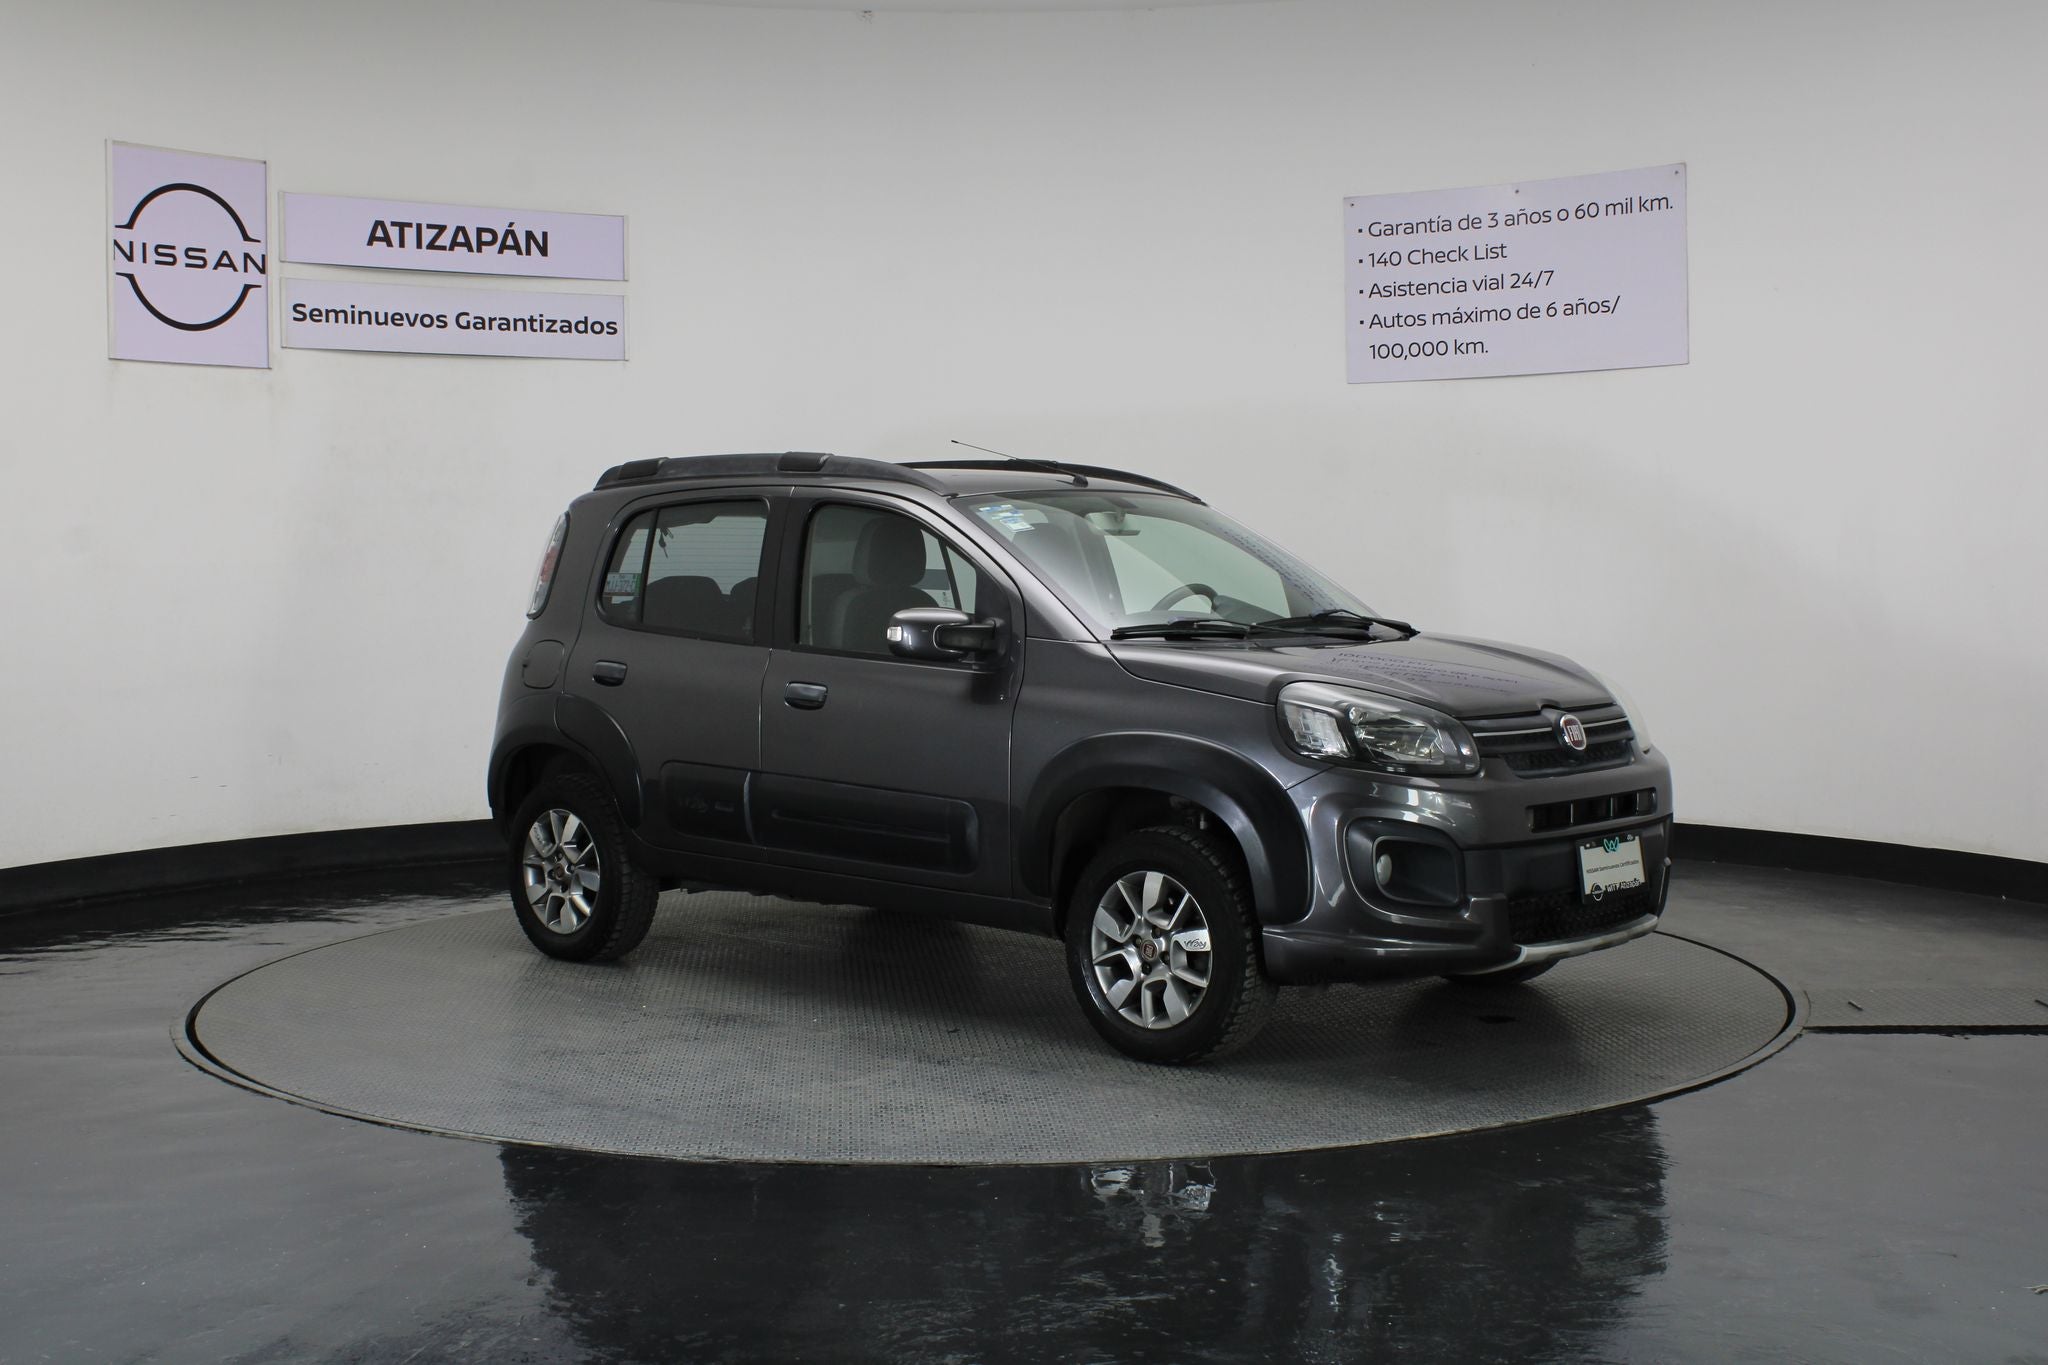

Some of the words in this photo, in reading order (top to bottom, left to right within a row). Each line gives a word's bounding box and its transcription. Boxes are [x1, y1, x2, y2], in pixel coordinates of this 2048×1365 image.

[1368, 216, 1452, 238] Garantía
[1458, 214, 1482, 230] de
[1488, 212, 1498, 228] 3
[1505, 209, 1551, 226] años
[1557, 209, 1569, 221] o
[1575, 202, 1599, 219] 60
[1606, 197, 1632, 216] mil
[1639, 196, 1673, 212] km.
[367, 220, 548, 257] ATIZAPÁN
[114, 238, 266, 275] NISSAN
[1369, 251, 1402, 267] 140
[1408, 246, 1469, 265] Check
[1475, 244, 1507, 260] List
[1369, 277, 1467, 298] Asistencia
[1473, 274, 1504, 291] vial
[1510, 270, 1554, 289] 24/7
[293, 303, 448, 329] Seminuevos
[455, 312, 618, 335] Garantizados
[1369, 313, 1426, 329] Autos
[1432, 307, 1511, 325] máximo
[1517, 303, 1540, 319] de
[1546, 302, 1557, 317] 6
[1563, 296, 1620, 316] años/
[1369, 341, 1448, 360] 100,000
[1454, 339, 1488, 355] km.
